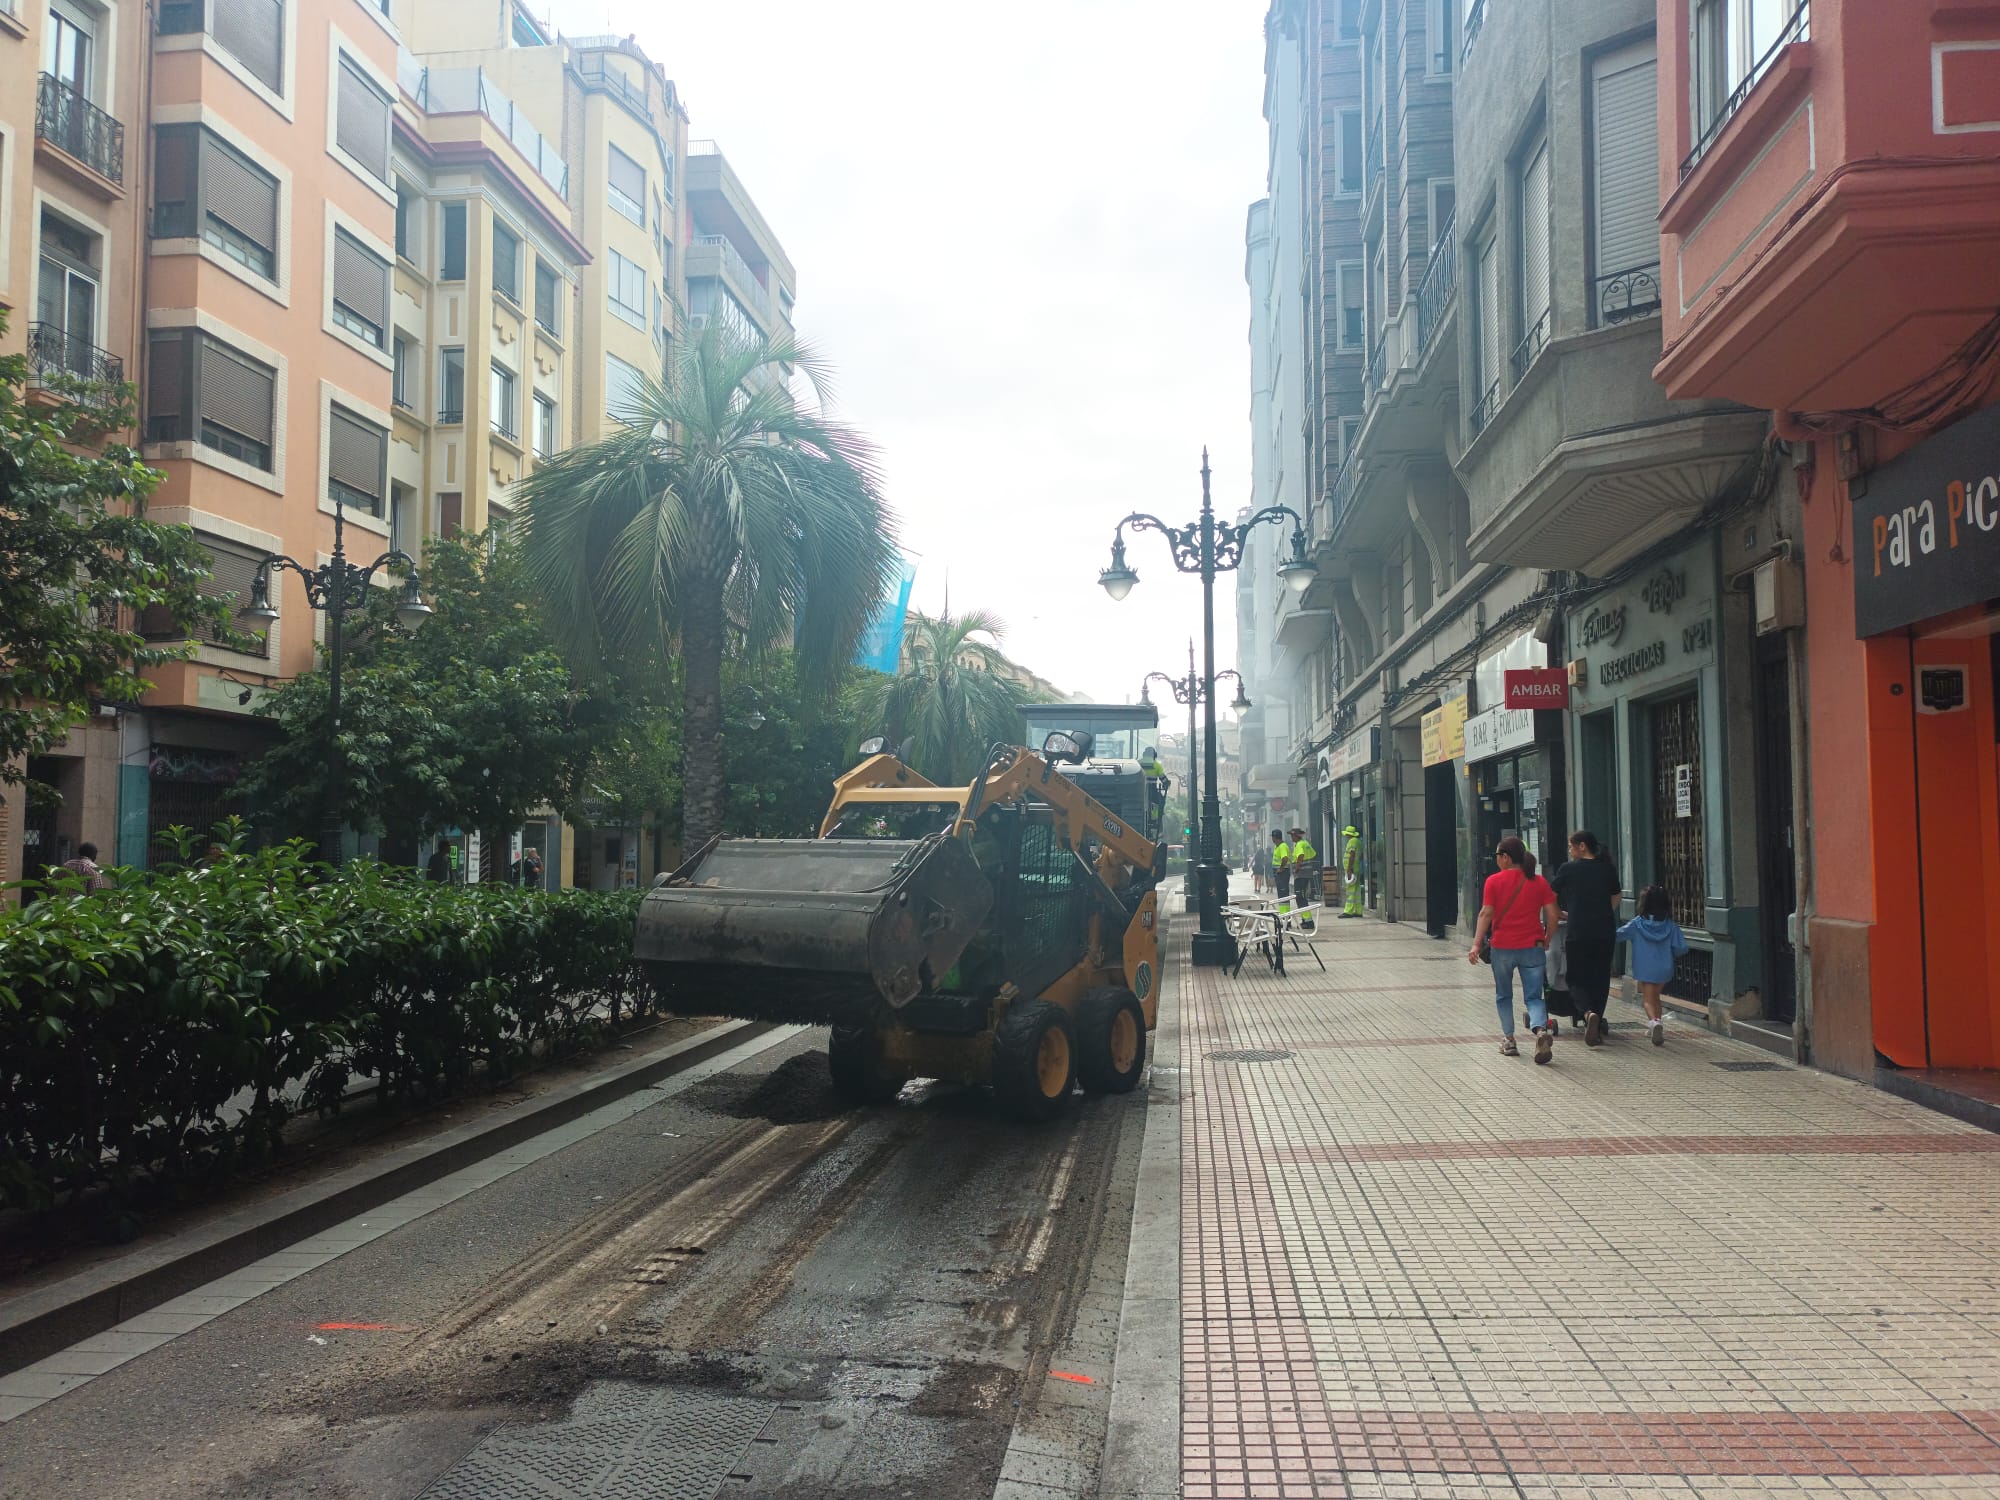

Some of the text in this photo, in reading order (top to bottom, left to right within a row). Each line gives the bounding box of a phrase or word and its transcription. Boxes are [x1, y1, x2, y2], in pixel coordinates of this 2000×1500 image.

[1873, 499, 1936, 577] Para
[1582, 605, 1627, 648] SEMILLAS
[1600, 640, 1666, 686] INSECTICIDAS
[1511, 683, 1562, 696] AMBAR
[1473, 721, 1488, 747] BAR
[1499, 708, 1530, 738] FORTUNA
